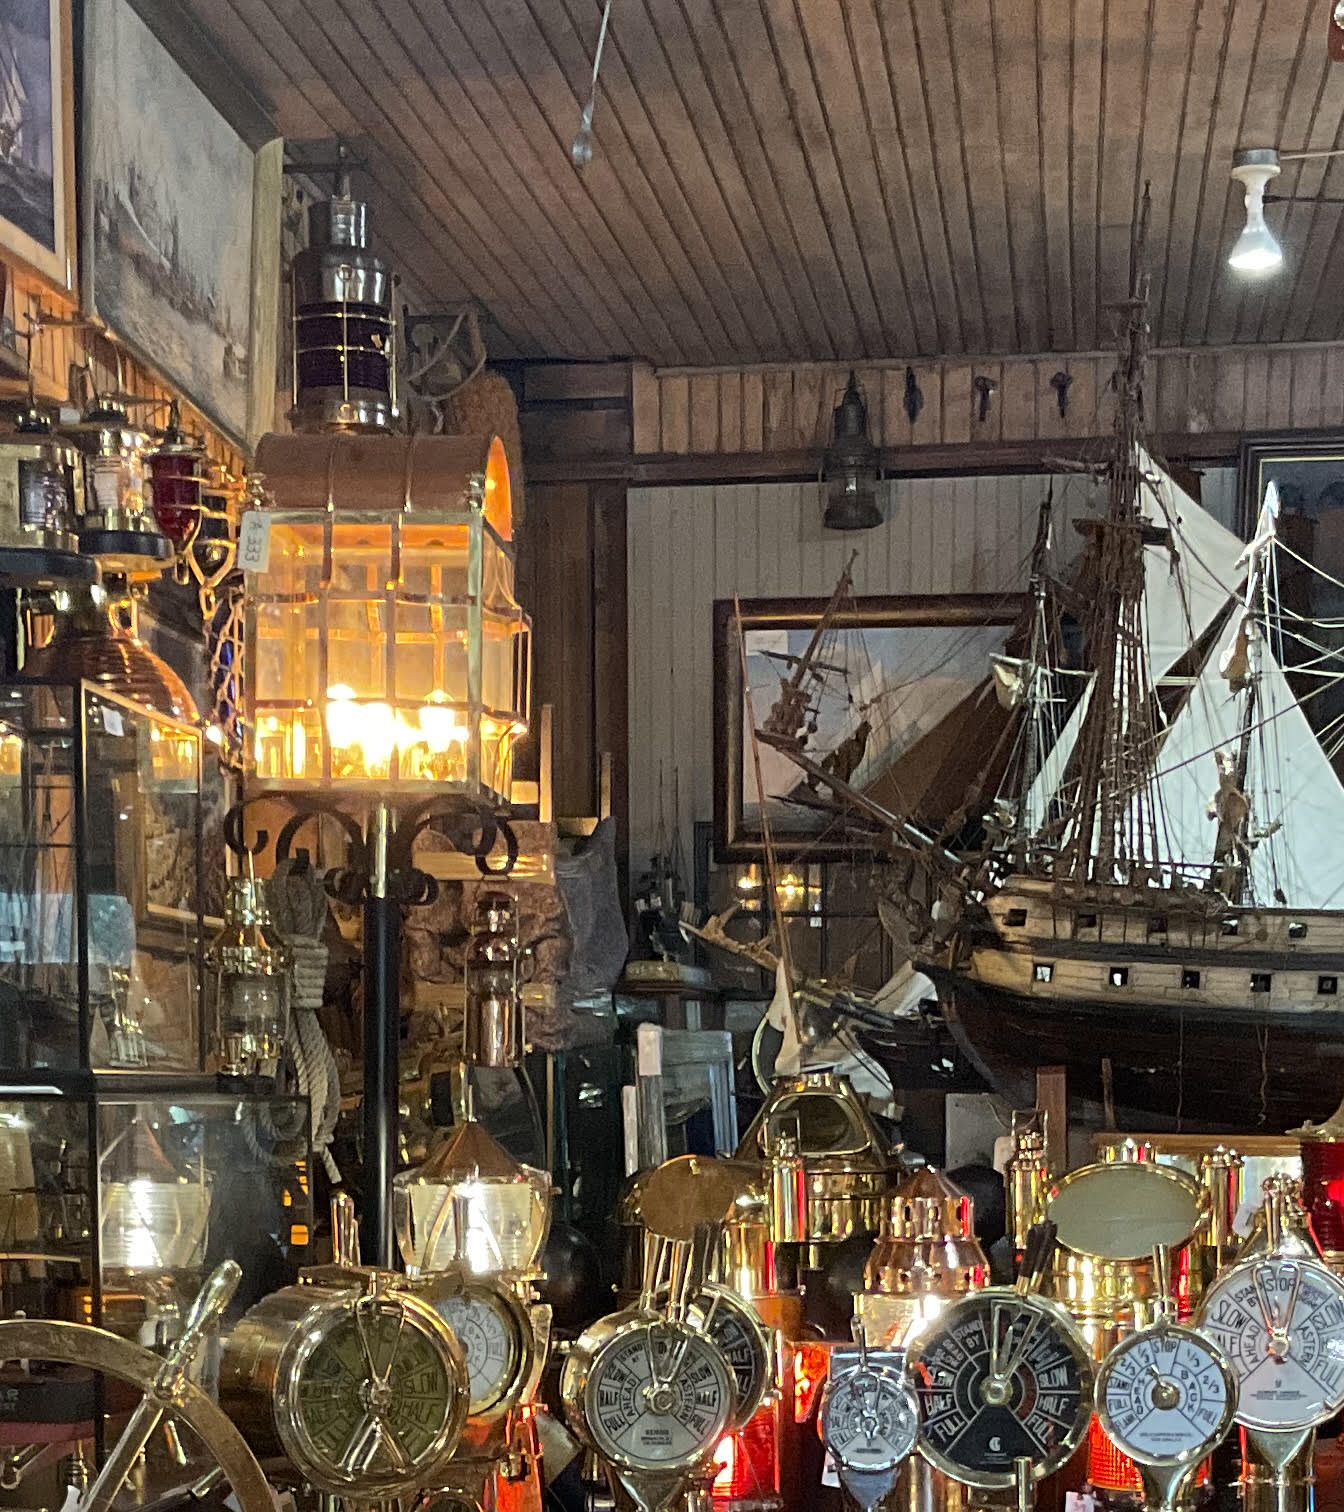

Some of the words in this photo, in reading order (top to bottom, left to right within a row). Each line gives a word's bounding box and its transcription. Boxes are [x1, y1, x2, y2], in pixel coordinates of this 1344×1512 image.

[1265, 1277, 1296, 1292] STOP
[1211, 1299, 1247, 1328] SLOW
[924, 1394, 953, 1416] HALF
[1039, 1395, 1069, 1416] HALF
[604, 1415, 626, 1435] FULL
[934, 1414, 966, 1443] FULL
